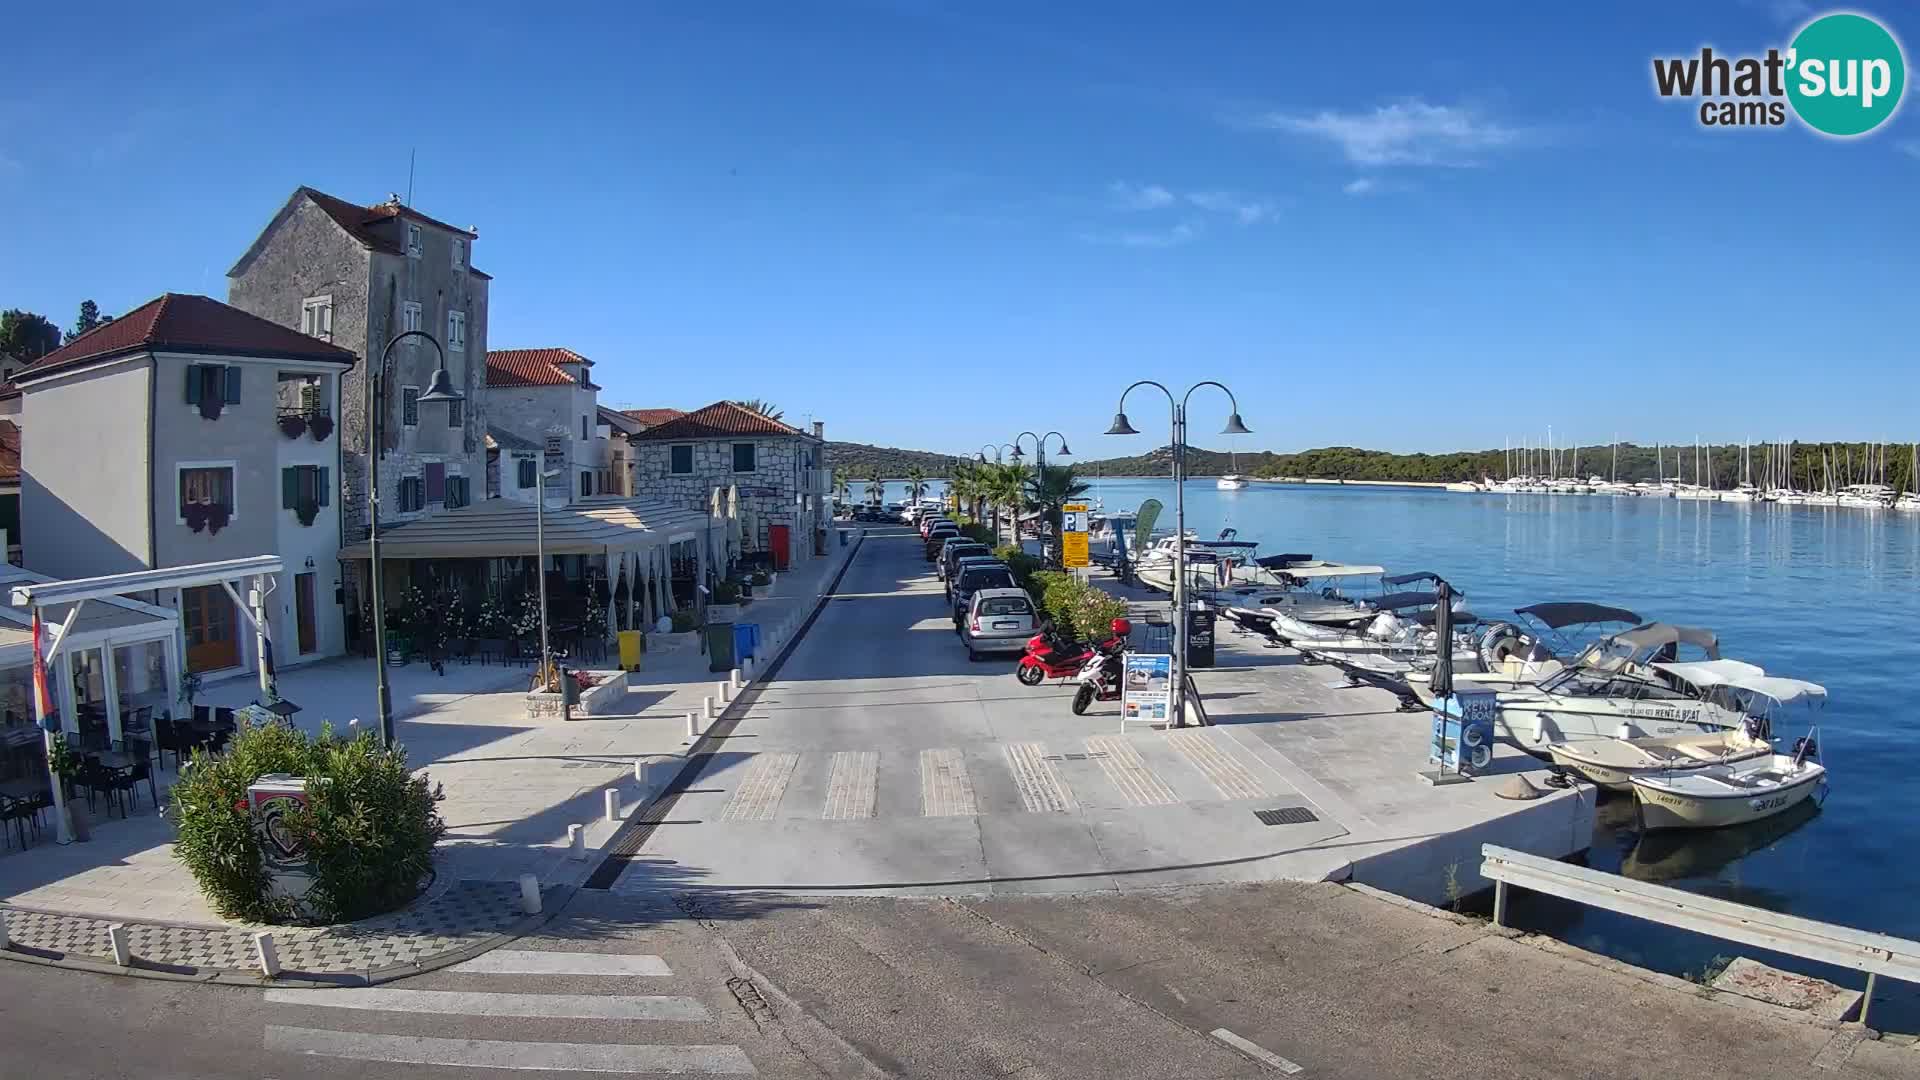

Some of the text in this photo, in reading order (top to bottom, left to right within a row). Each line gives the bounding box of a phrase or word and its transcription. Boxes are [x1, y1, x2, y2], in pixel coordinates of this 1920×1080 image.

[1064, 513, 1076, 530] P
[1463, 701, 1494, 712] RENT
[1463, 711, 1495, 720] A BOAT
[1655, 708, 1675, 718] RENT
[1675, 709, 1681, 719] A
